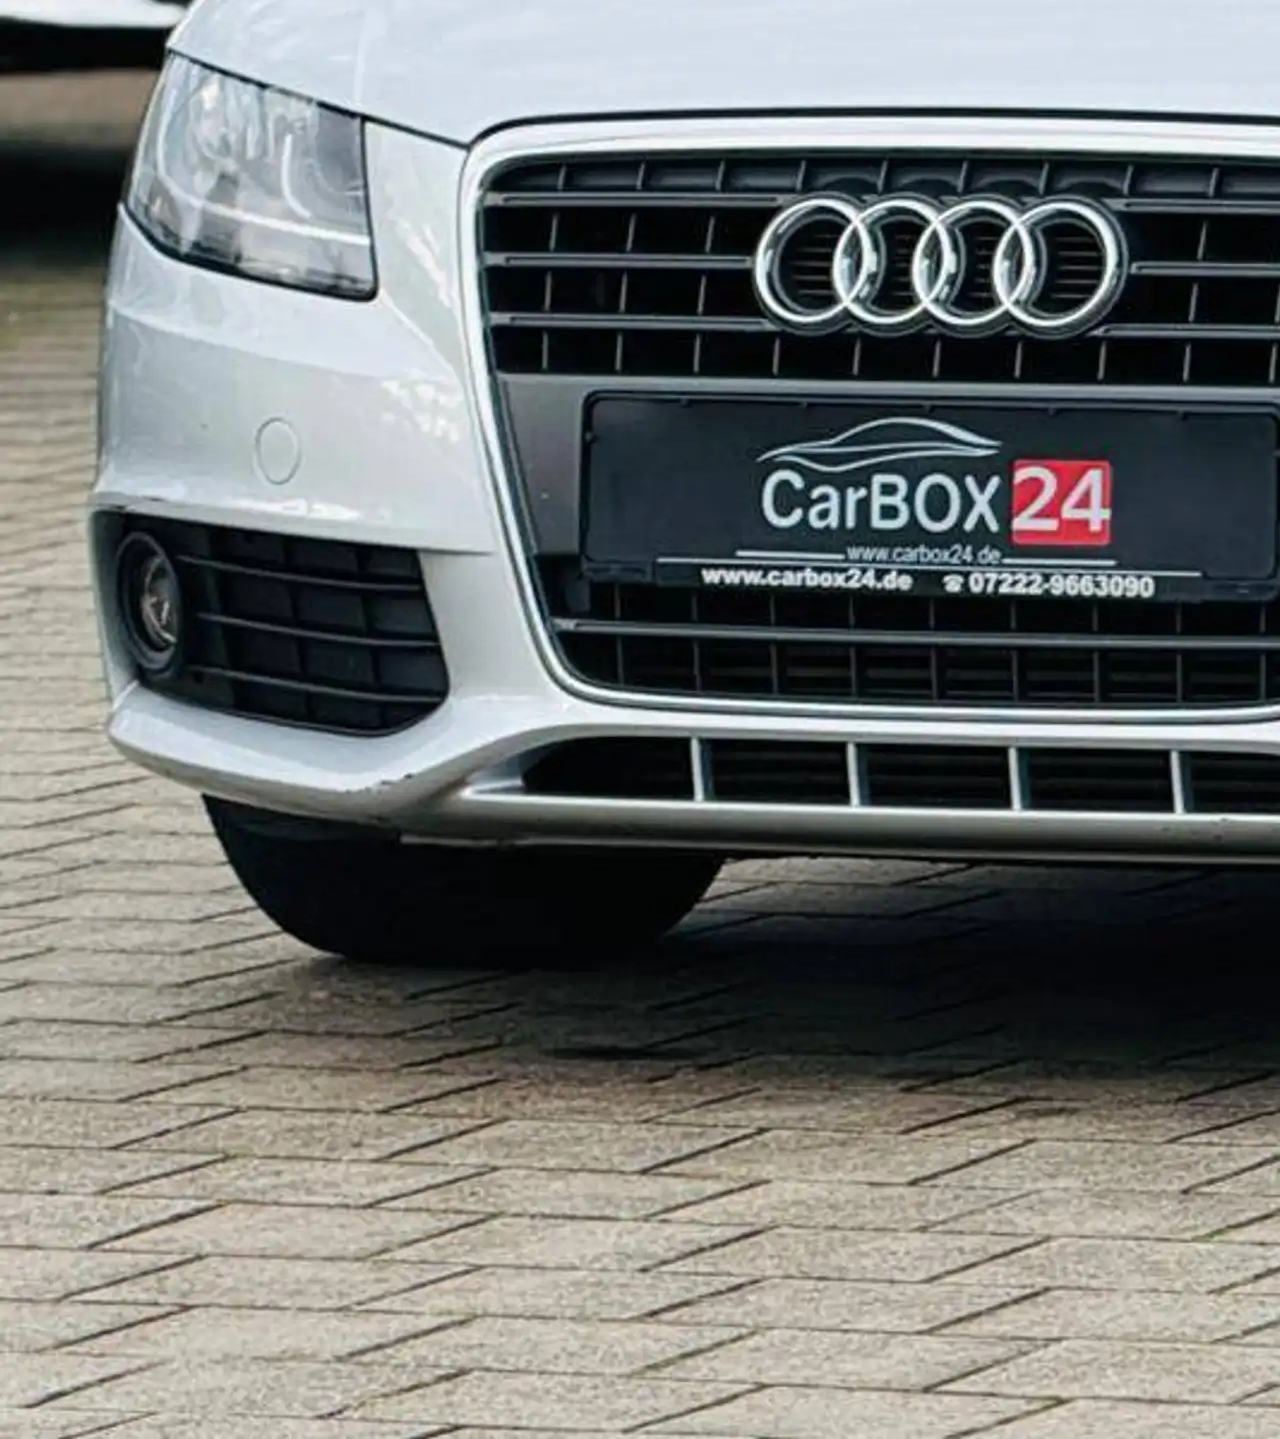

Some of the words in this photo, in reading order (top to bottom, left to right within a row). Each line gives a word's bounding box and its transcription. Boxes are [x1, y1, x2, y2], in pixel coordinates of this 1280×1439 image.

[846, 543, 1001, 564] www.carbox24.de
[701, 566, 914, 591] www.carbox24.de
[968, 573, 1156, 598] 07222-9663090
